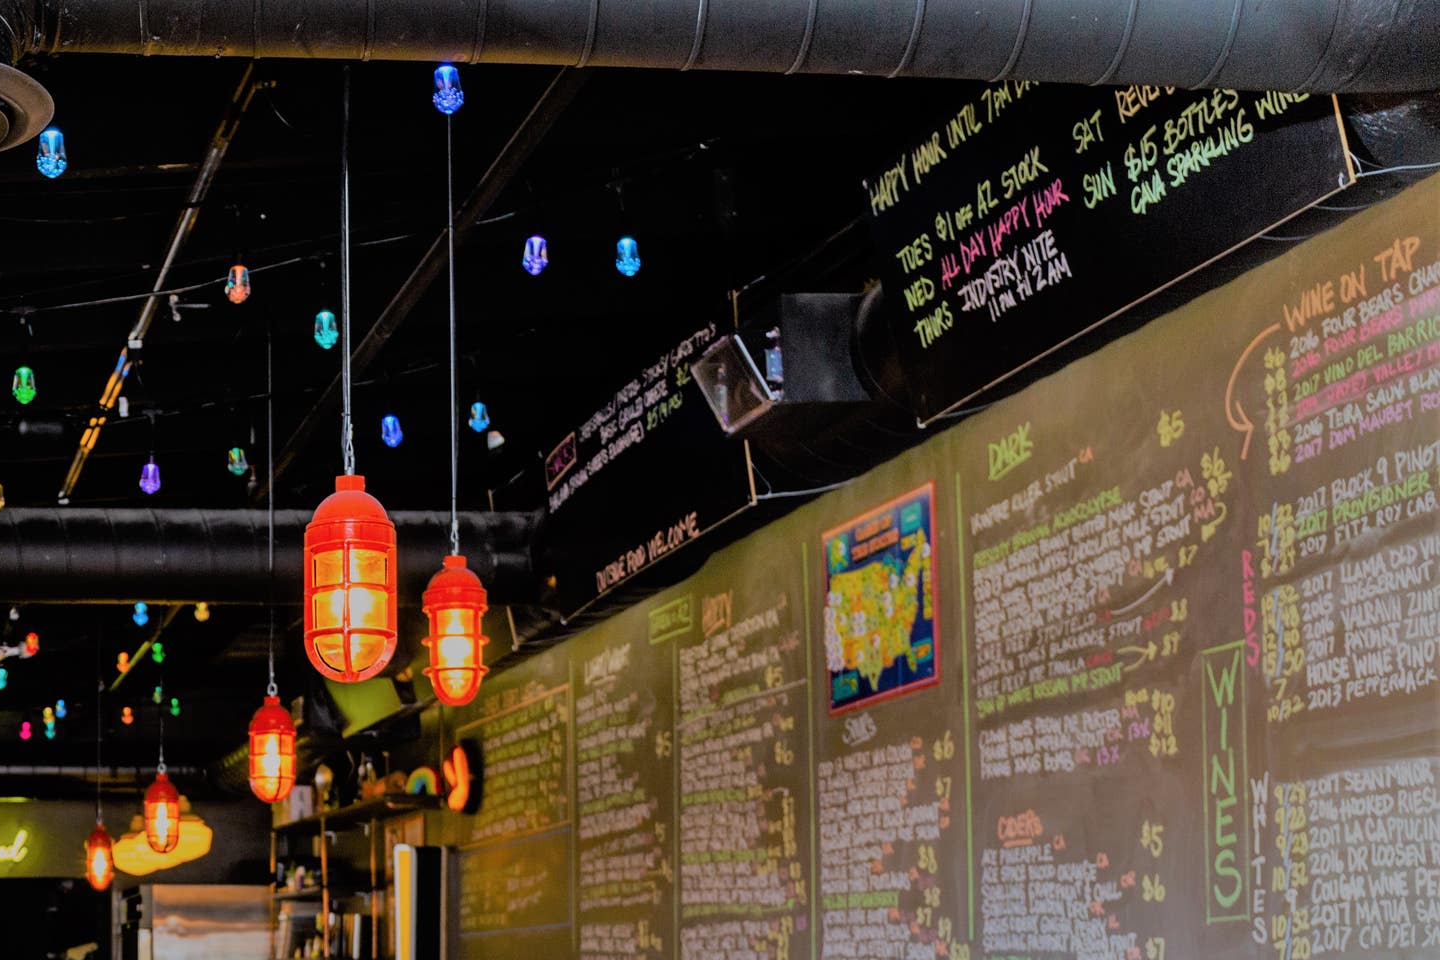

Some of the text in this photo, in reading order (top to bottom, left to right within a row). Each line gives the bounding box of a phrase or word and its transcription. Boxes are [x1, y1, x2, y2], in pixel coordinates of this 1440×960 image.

[1072, 109, 1104, 154] SAT
[1082, 86, 1239, 210] SUN $15 BOTTLES
[1166, 107, 1254, 187] SPARKLING
[869, 154, 910, 217] HAPPY
[912, 131, 948, 184] HOUR
[896, 232, 933, 274] TUES
[1001, 145, 1049, 200] STOCK
[941, 252, 961, 290] ALL
[960, 229, 988, 275] DAY
[987, 195, 1031, 258] HAPPY
[1032, 178, 1071, 229] HOUR
[913, 229, 1059, 349] THURS INDUSTRY NITE
[1283, 236, 1422, 333] WINE ON TAP
[1322, 305, 1358, 338] FOUR
[1358, 283, 1404, 323] BEARS
[1323, 356, 1354, 386] VINO
[1356, 342, 1385, 369] DEL
[987, 421, 1034, 480] DARK
[1306, 647, 1393, 689] HOUSE WINE
[1206, 649, 1244, 908] WINES
[1139, 819, 1164, 858] $5
[1250, 771, 1269, 944] WHITES
[1310, 901, 1351, 926] 2017
[1311, 925, 1353, 955] 2017
